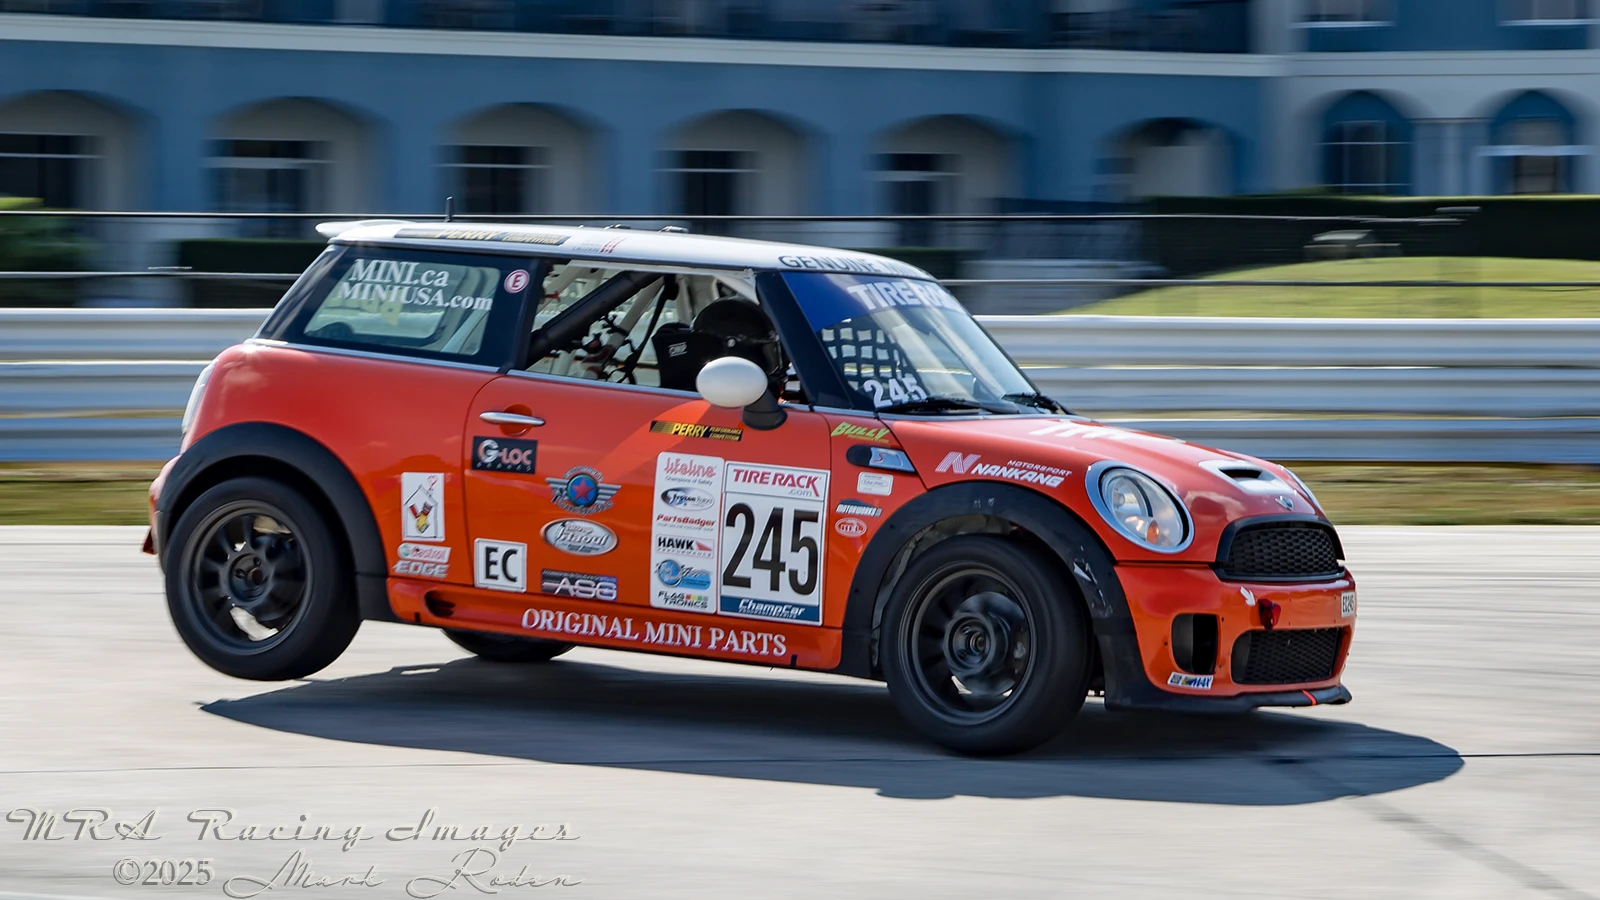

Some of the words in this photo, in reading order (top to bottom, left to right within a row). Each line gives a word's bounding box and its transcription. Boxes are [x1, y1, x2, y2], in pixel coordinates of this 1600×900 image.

[348, 258, 449, 287] MINI.ca
[779, 255, 881, 273] GENUINE
[511, 274, 523, 289] E
[337, 281, 493, 310] MINIUSA.com
[847, 281, 922, 310] TIRE
[863, 373, 928, 408] 245
[672, 423, 708, 438] PERRY
[831, 421, 890, 440] BULLY
[971, 463, 1065, 487] NANKANG
[1007, 459, 1072, 476] MOTORSPORT
[733, 468, 770, 485] TIRE
[771, 472, 820, 497] RACK
[788, 488, 812, 497] .com
[656, 514, 716, 527] PartsBadger
[658, 536, 694, 550] HAWK
[722, 502, 820, 596] 245
[393, 560, 450, 579] EDGE
[485, 546, 518, 583] EC
[658, 590, 685, 600] FLAG
[663, 598, 708, 609] TRONICS
[738, 597, 805, 616] ChampCar
[521, 608, 640, 641] ORIGINAL
[642, 621, 702, 647] MINI
[707, 627, 787, 657] PARTS
